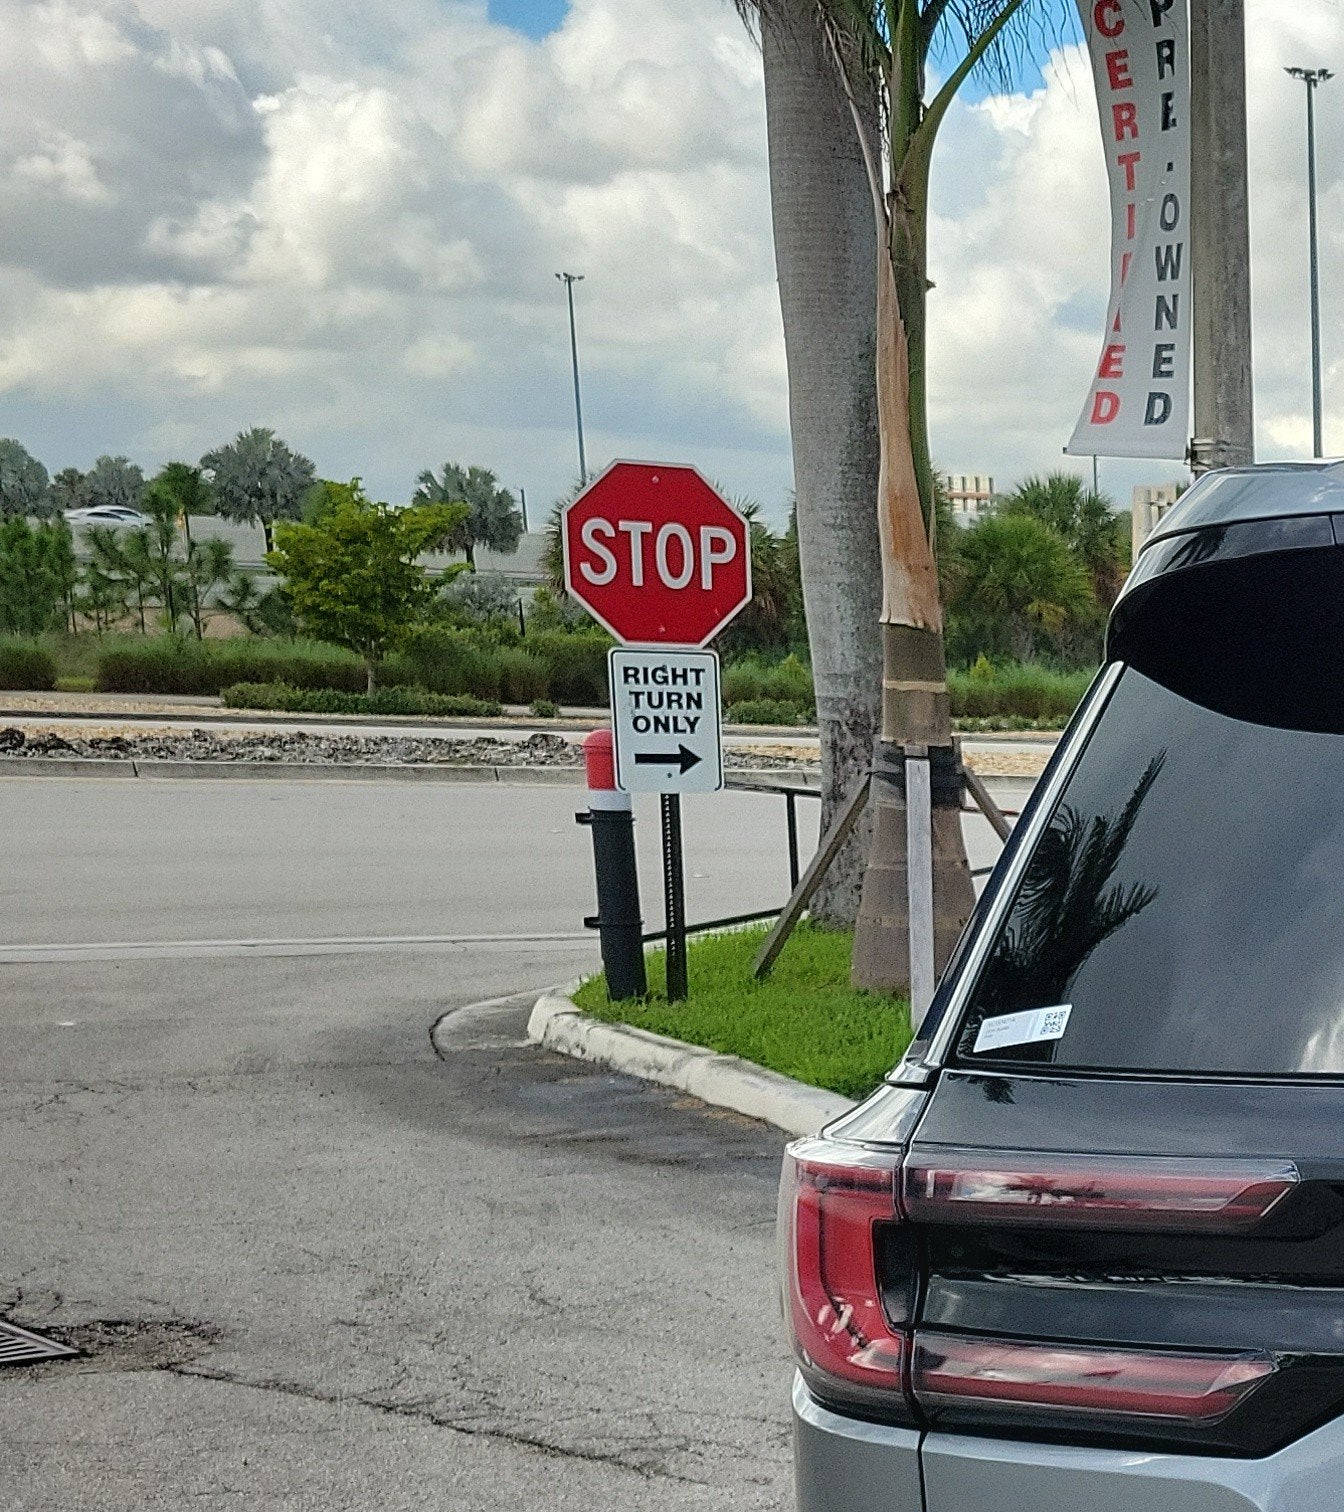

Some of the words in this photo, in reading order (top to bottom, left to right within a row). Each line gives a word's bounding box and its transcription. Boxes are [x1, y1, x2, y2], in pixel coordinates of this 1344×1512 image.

[579, 516, 737, 591] STOP
[622, 666, 706, 686] RIGHT
[629, 691, 703, 711] TURN
[632, 715, 701, 735] ONLY
